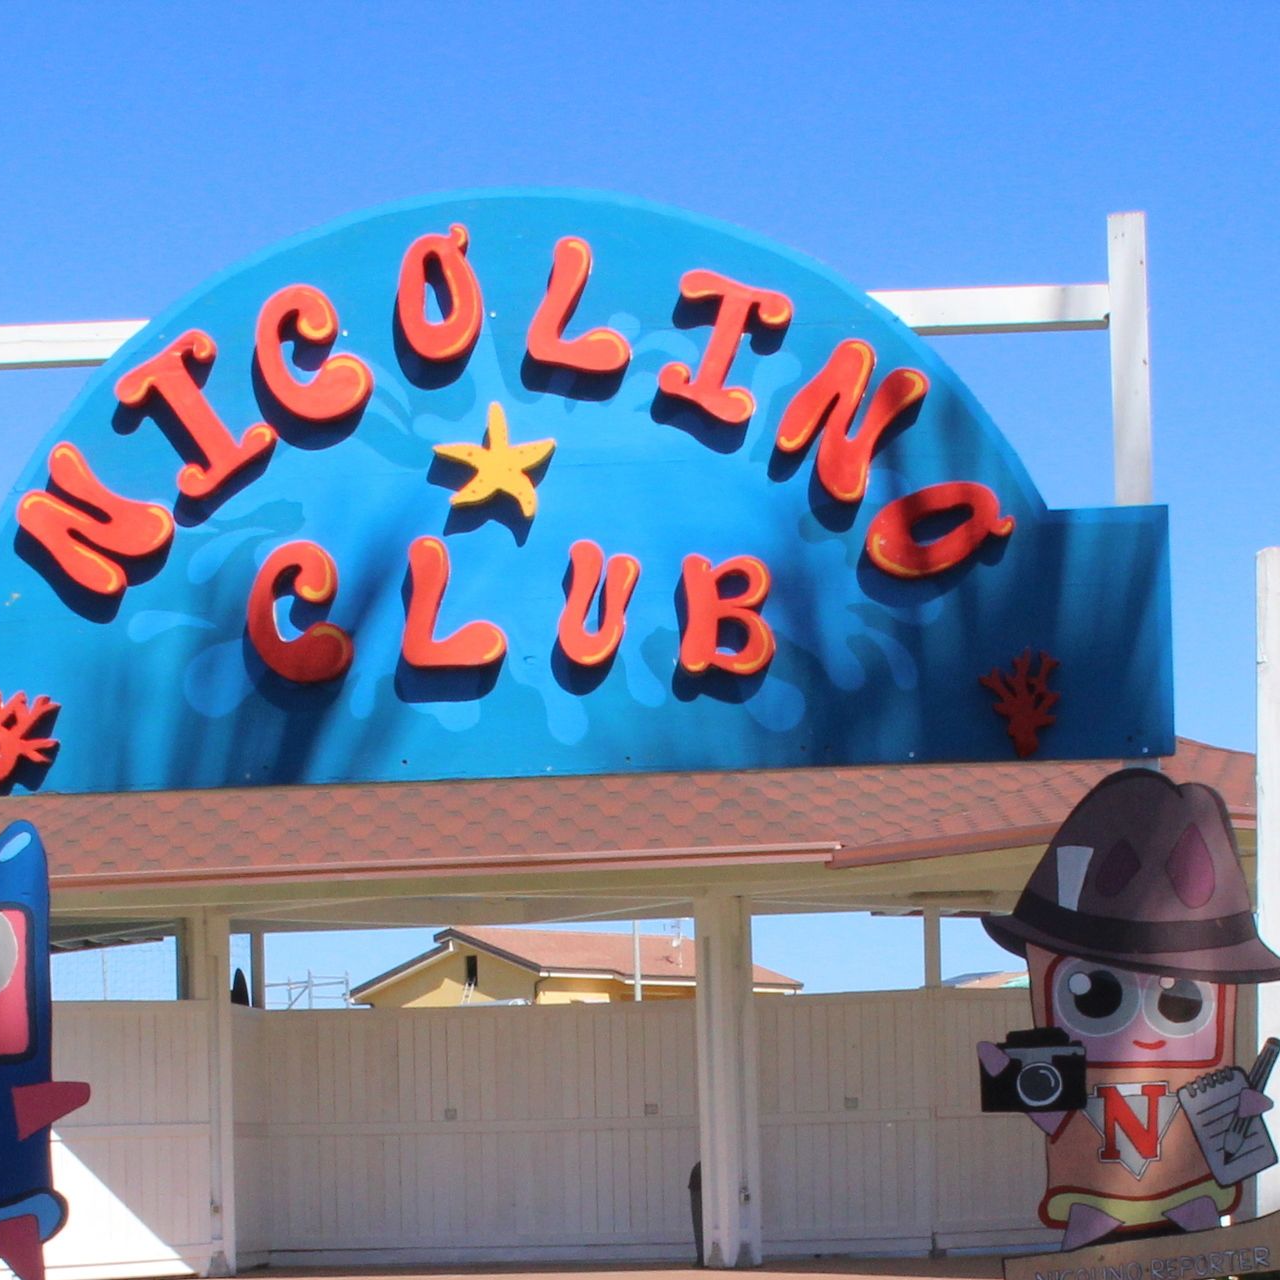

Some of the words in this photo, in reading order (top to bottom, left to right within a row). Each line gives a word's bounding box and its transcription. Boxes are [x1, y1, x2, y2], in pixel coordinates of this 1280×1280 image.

[16, 223, 1013, 594] NICOLINO
[248, 536, 776, 682] CLUB
[1096, 1083, 1169, 1162] N
